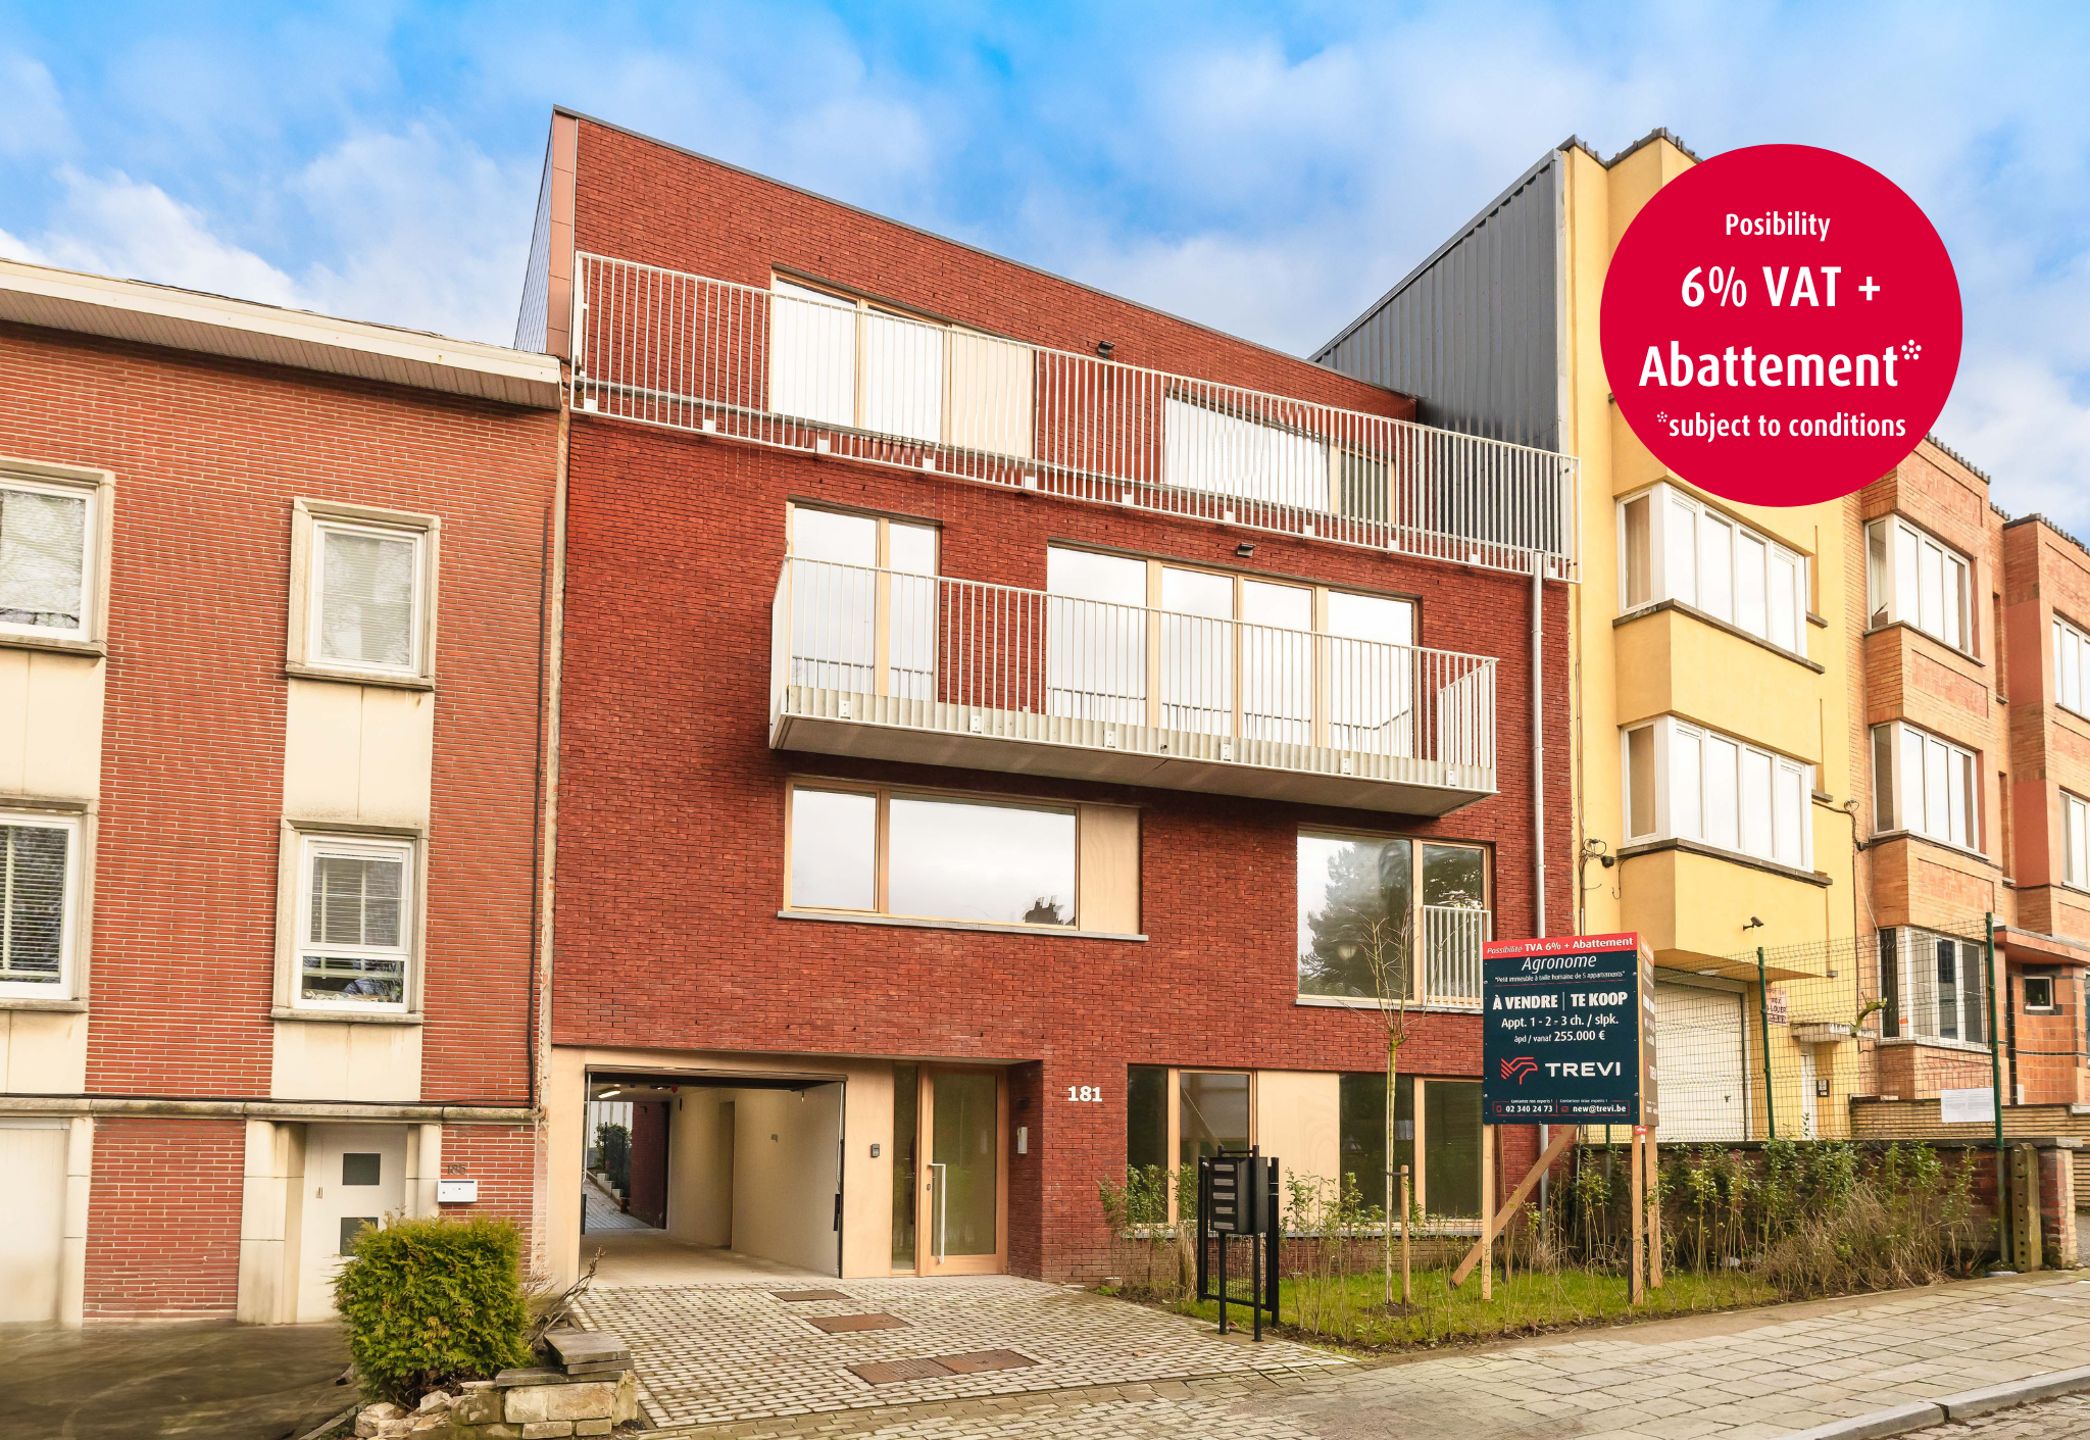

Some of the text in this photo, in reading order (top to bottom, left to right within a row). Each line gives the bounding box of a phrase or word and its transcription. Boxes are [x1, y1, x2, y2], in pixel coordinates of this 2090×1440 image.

[1524, 943, 1543, 952] TVA
[1545, 941, 1561, 951] 6%
[1572, 937, 1633, 949] Abattement
[1521, 955, 1597, 974] Agronome
[1505, 994, 1558, 1010] VENDRE
[1570, 993, 1586, 1008] TE
[1588, 992, 1628, 1007] KOOP
[1501, 1018, 1527, 1030] Appt.
[1530, 1016, 1535, 1027] 1
[1545, 1016, 1552, 1026] 2
[1560, 1016, 1568, 1026] 3
[1570, 1014, 1584, 1026] ch.
[1594, 1012, 1619, 1028] slpk.
[1533, 1034, 1552, 1042] vanaf
[1554, 1030, 1596, 1042] 255.000
[1598, 1030, 1606, 1040] €
[1545, 1062, 1621, 1078] TREVI
[1068, 1086, 1102, 1102] 181
[1572, 1104, 1626, 1114] new@trevi.be
